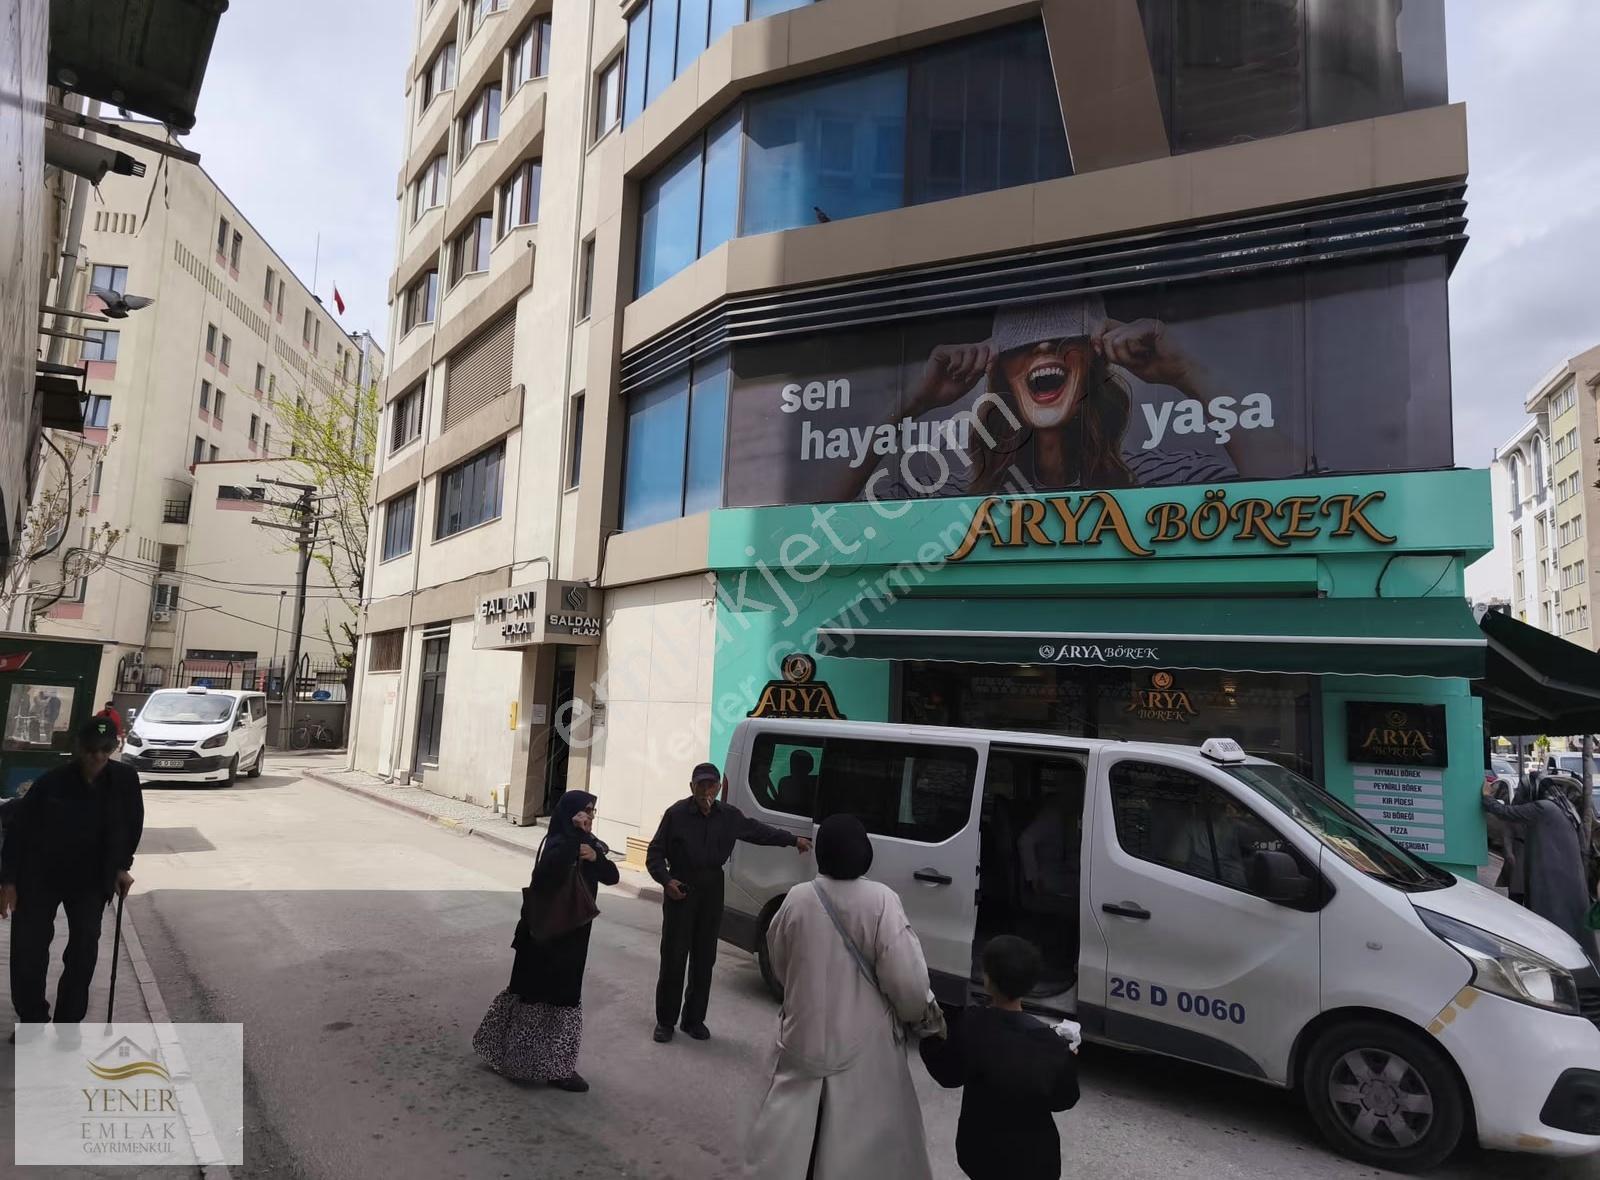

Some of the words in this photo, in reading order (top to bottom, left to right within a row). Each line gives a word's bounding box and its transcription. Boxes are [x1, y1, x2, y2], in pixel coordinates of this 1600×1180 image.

[780, 377, 850, 413] sen
[1141, 392, 1275, 450] yaşa
[801, 419, 969, 469] hayatını
[944, 491, 1156, 561] ARYA
[1146, 489, 1398, 547] BÖREK
[481, 591, 536, 617] SALDAN
[501, 622, 530, 636] PLAZA
[549, 614, 600, 628] SALDAN
[572, 627, 600, 636] PLAZA
[1054, 645, 1106, 662] ARYA
[1104, 645, 1160, 660] BÖREK
[749, 686, 841, 719] ARYA
[1127, 690, 1198, 715] ARYA
[1361, 727, 1433, 751] ARYA
[1400, 769, 1421, 778] BÖREK
[1402, 783, 1422, 792] BÖREK
[1382, 797, 1393, 805] KIR
[1383, 811, 1391, 819] SU
[1390, 826, 1408, 835] PİZZA
[1110, 977, 1140, 1001] 26
[1150, 985, 1168, 1007] D
[1177, 991, 1246, 1025] 0060
